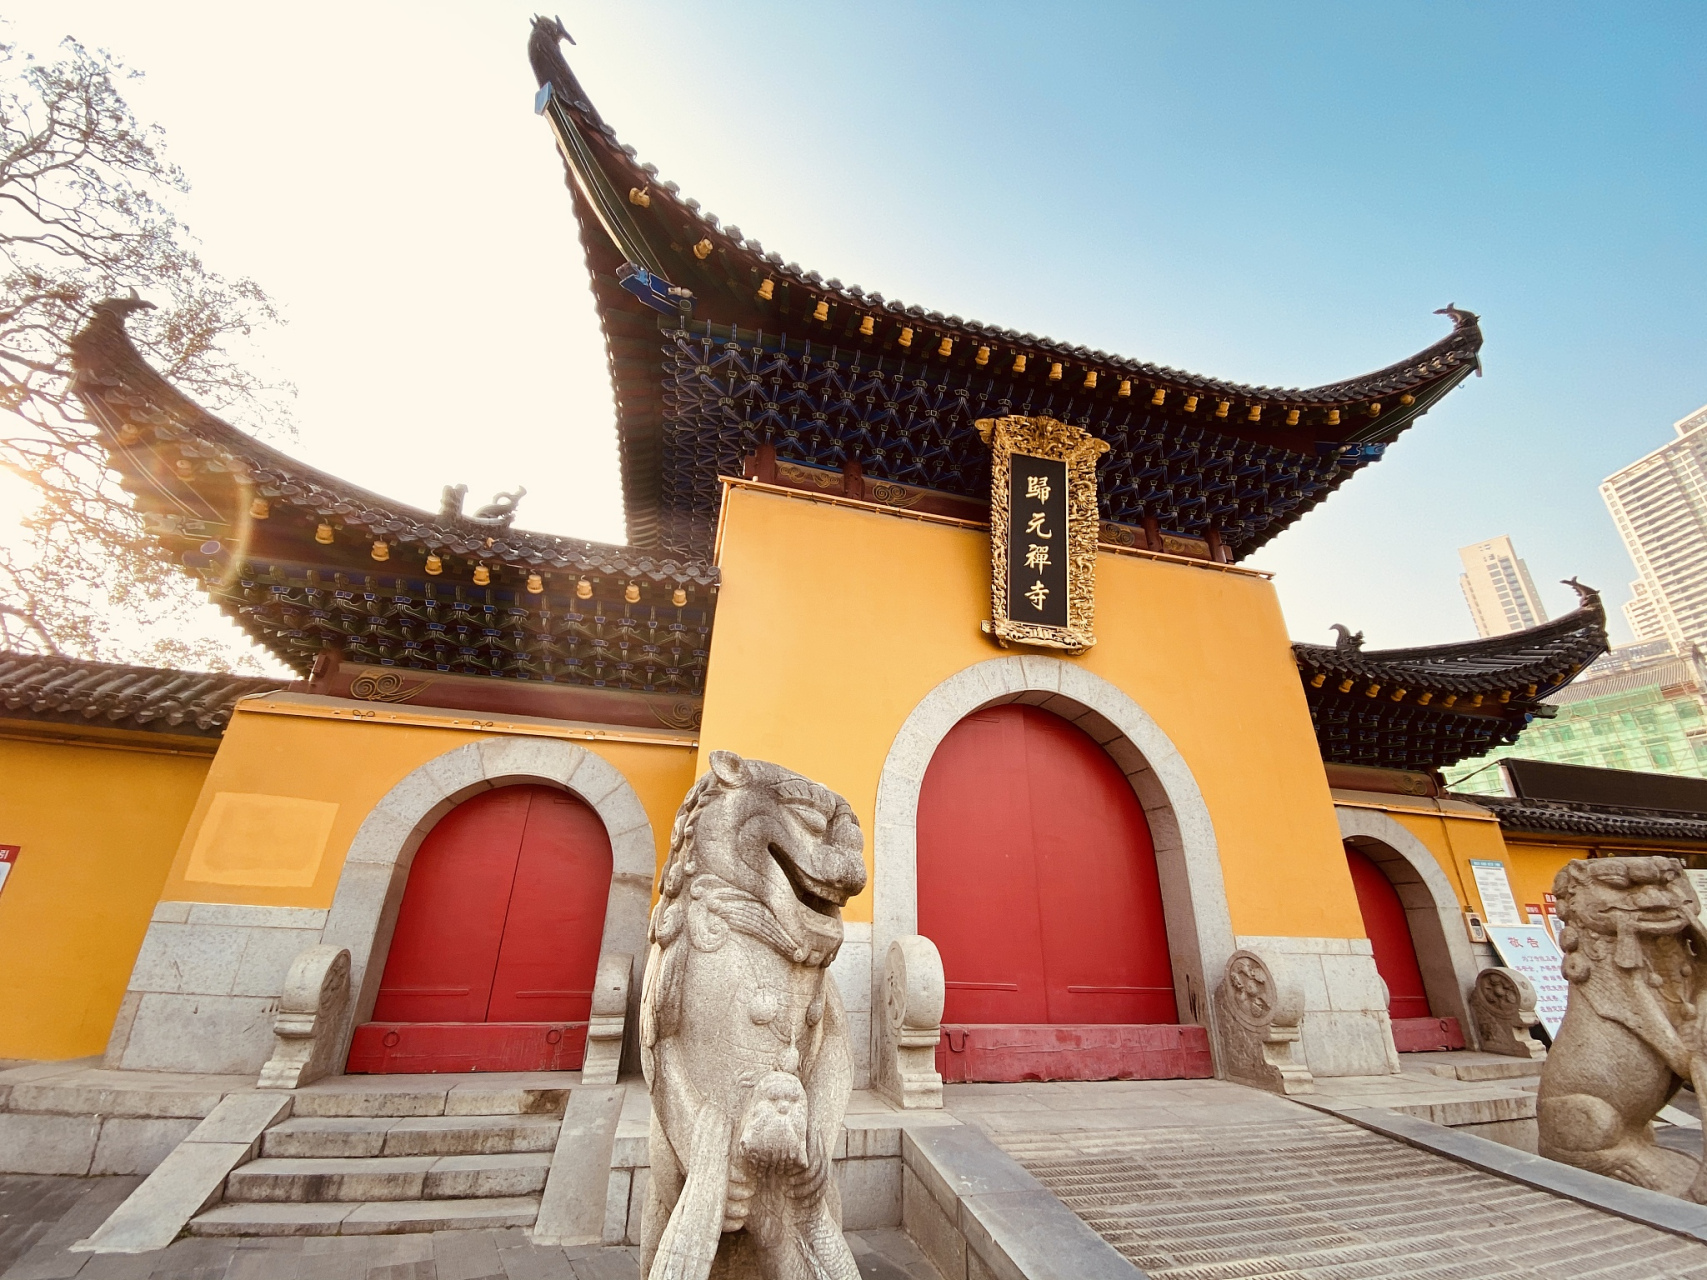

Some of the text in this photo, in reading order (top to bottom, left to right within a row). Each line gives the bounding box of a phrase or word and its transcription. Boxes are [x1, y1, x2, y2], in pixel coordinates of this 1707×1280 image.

[1023, 476, 1052, 610] 歸元禪寺
[1507, 936, 1540, 949] 敬告
